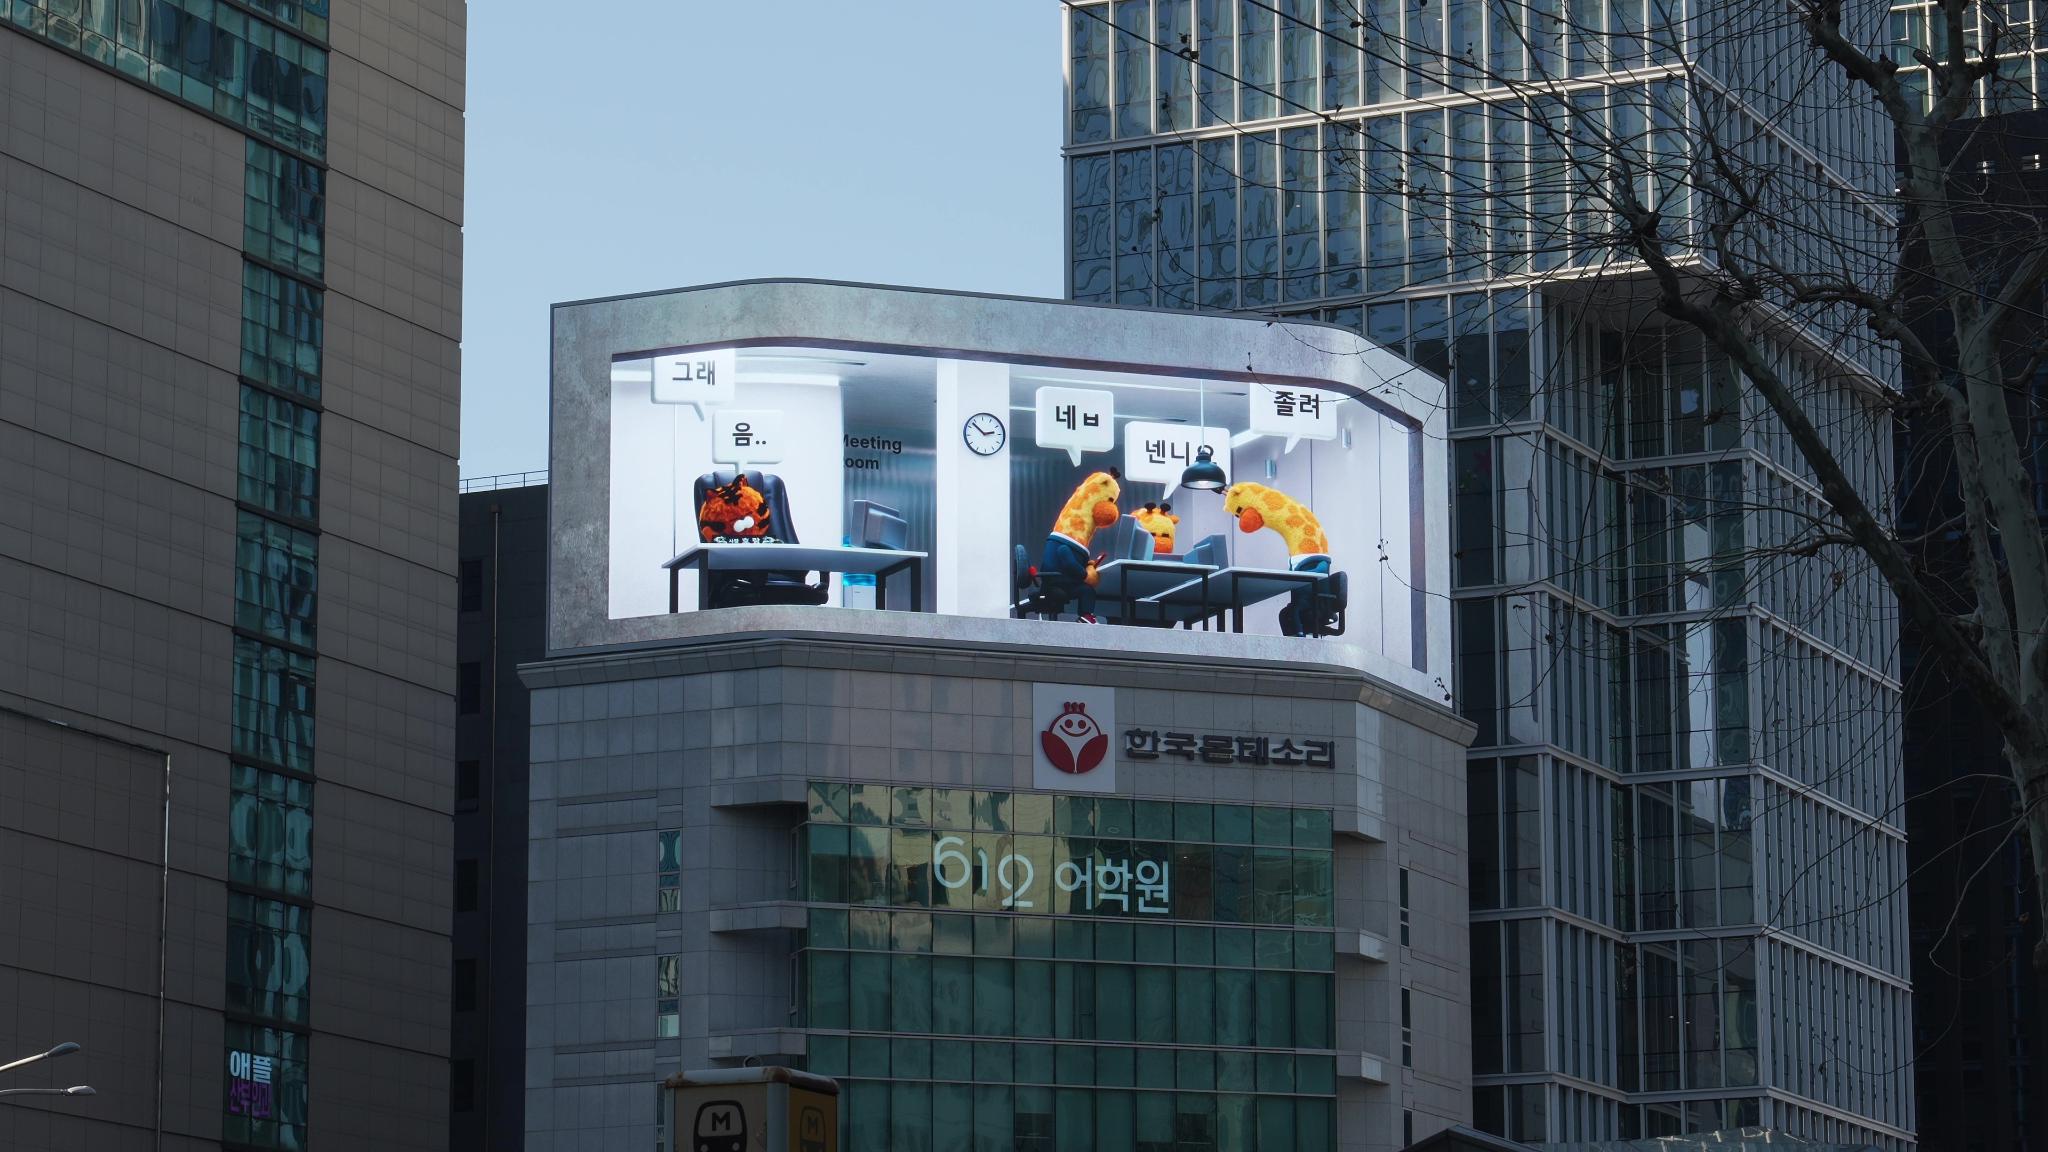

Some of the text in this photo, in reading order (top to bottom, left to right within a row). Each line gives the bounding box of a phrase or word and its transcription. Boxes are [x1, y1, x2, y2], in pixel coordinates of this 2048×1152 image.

[672, 360, 716, 386] 그래
[1273, 391, 1320, 420] 졸려
[732, 422, 767, 447] 음..
[844, 458, 880, 470] oom
[1125, 728, 1336, 769] 한국몬테소리
[1055, 857, 1169, 914] 어학원
[229, 1050, 273, 1085] 애플
[711, 1111, 731, 1132] M
